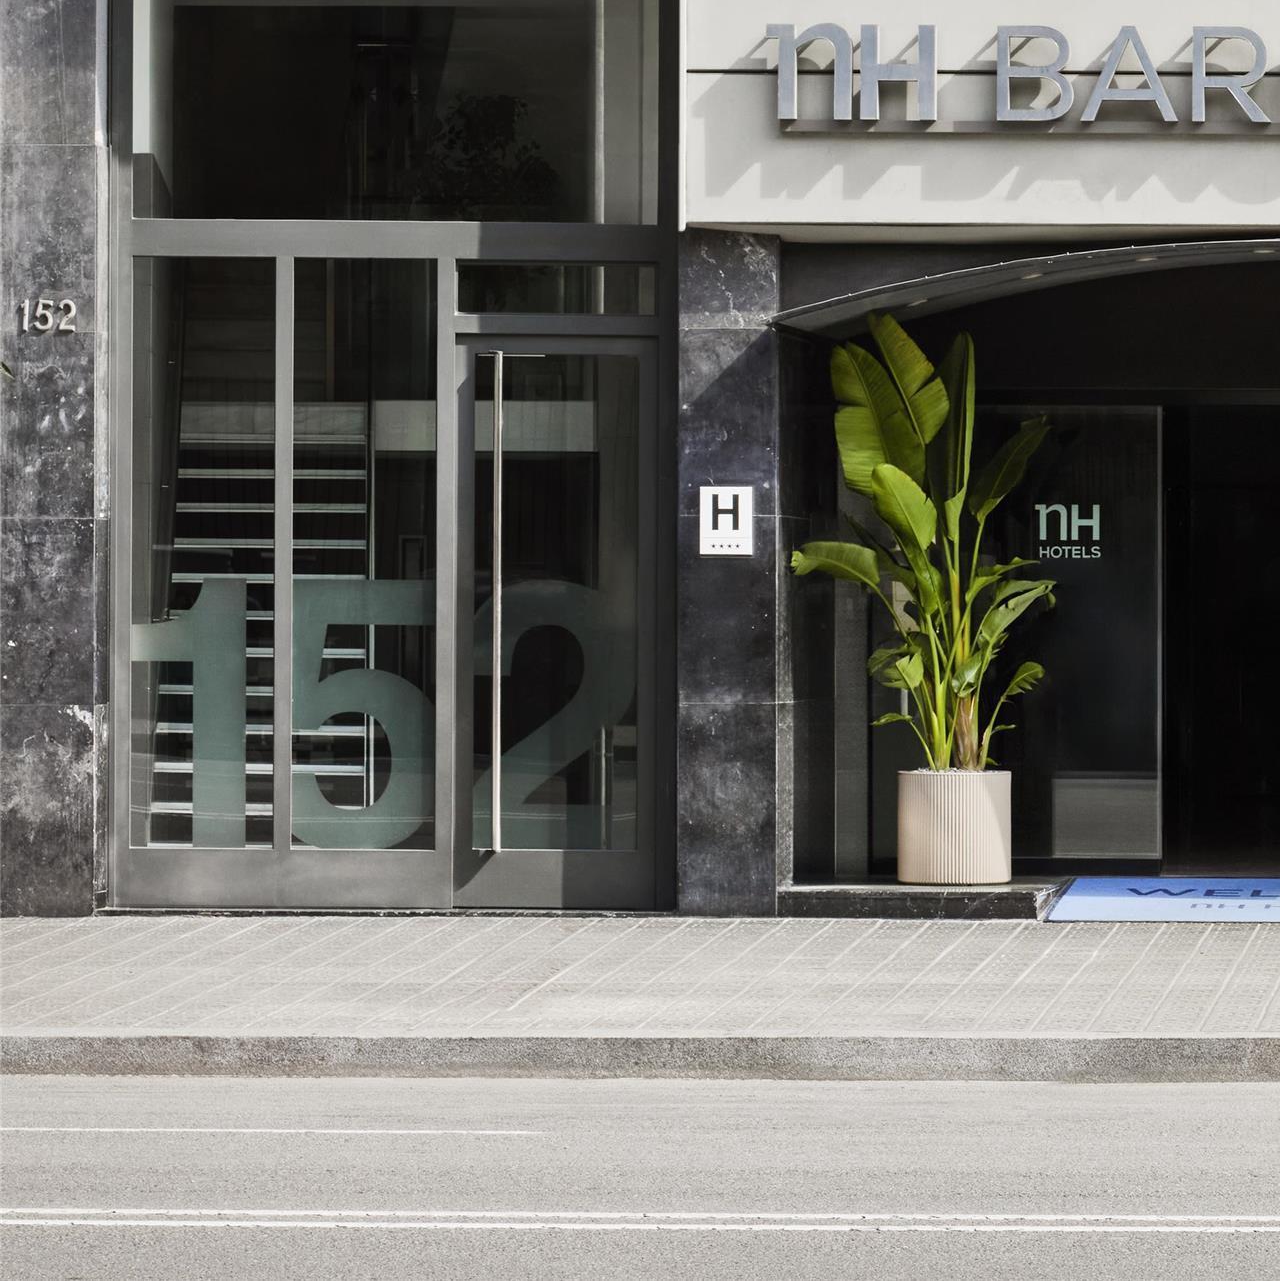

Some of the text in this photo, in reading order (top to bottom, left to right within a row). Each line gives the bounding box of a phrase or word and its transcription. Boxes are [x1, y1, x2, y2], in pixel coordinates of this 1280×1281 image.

[21, 299, 76, 331] 152
[712, 494, 739, 530] H
[1039, 546, 1101, 558] HOTELS
[130, 577, 639, 849] 152
